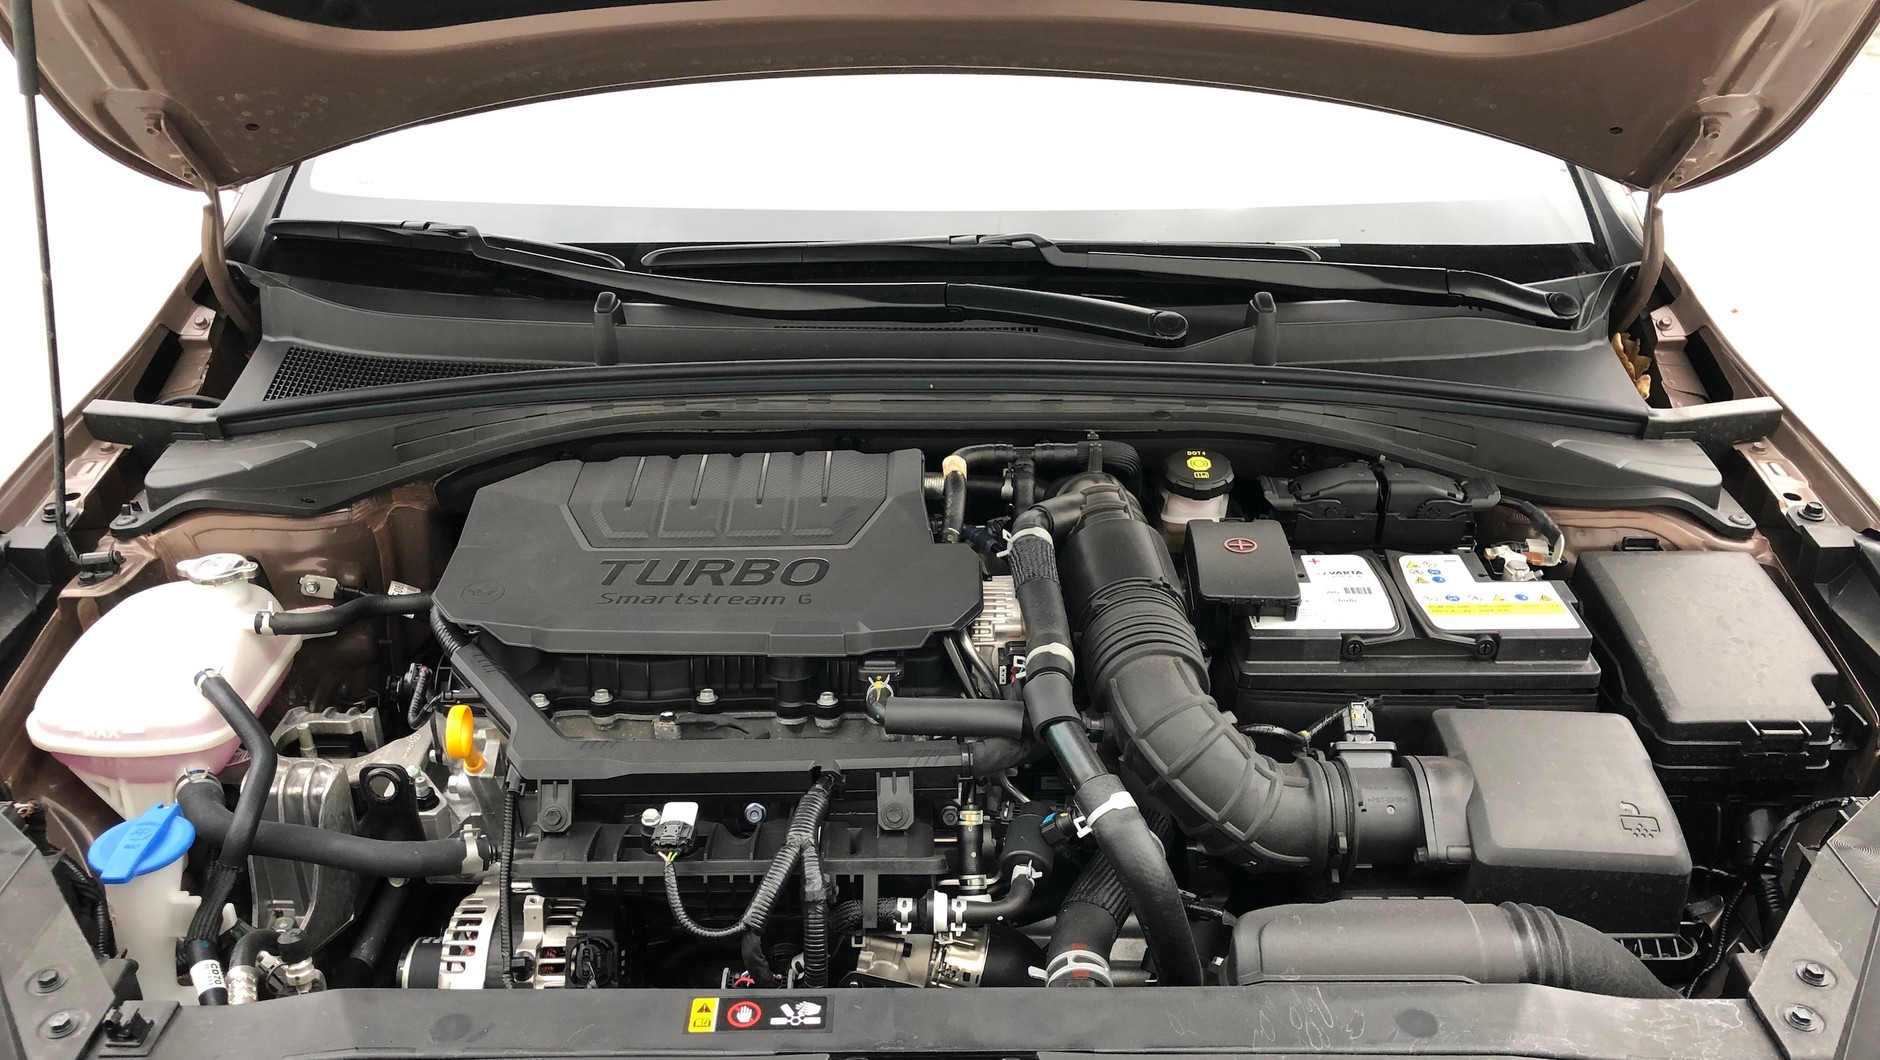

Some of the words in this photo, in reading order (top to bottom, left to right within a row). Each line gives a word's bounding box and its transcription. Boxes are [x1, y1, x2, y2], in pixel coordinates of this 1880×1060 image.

[599, 556, 831, 587] TURBO
[595, 592, 787, 606] Smartstream
[798, 594, 813, 605] G
[210, 963, 223, 985] CD70
